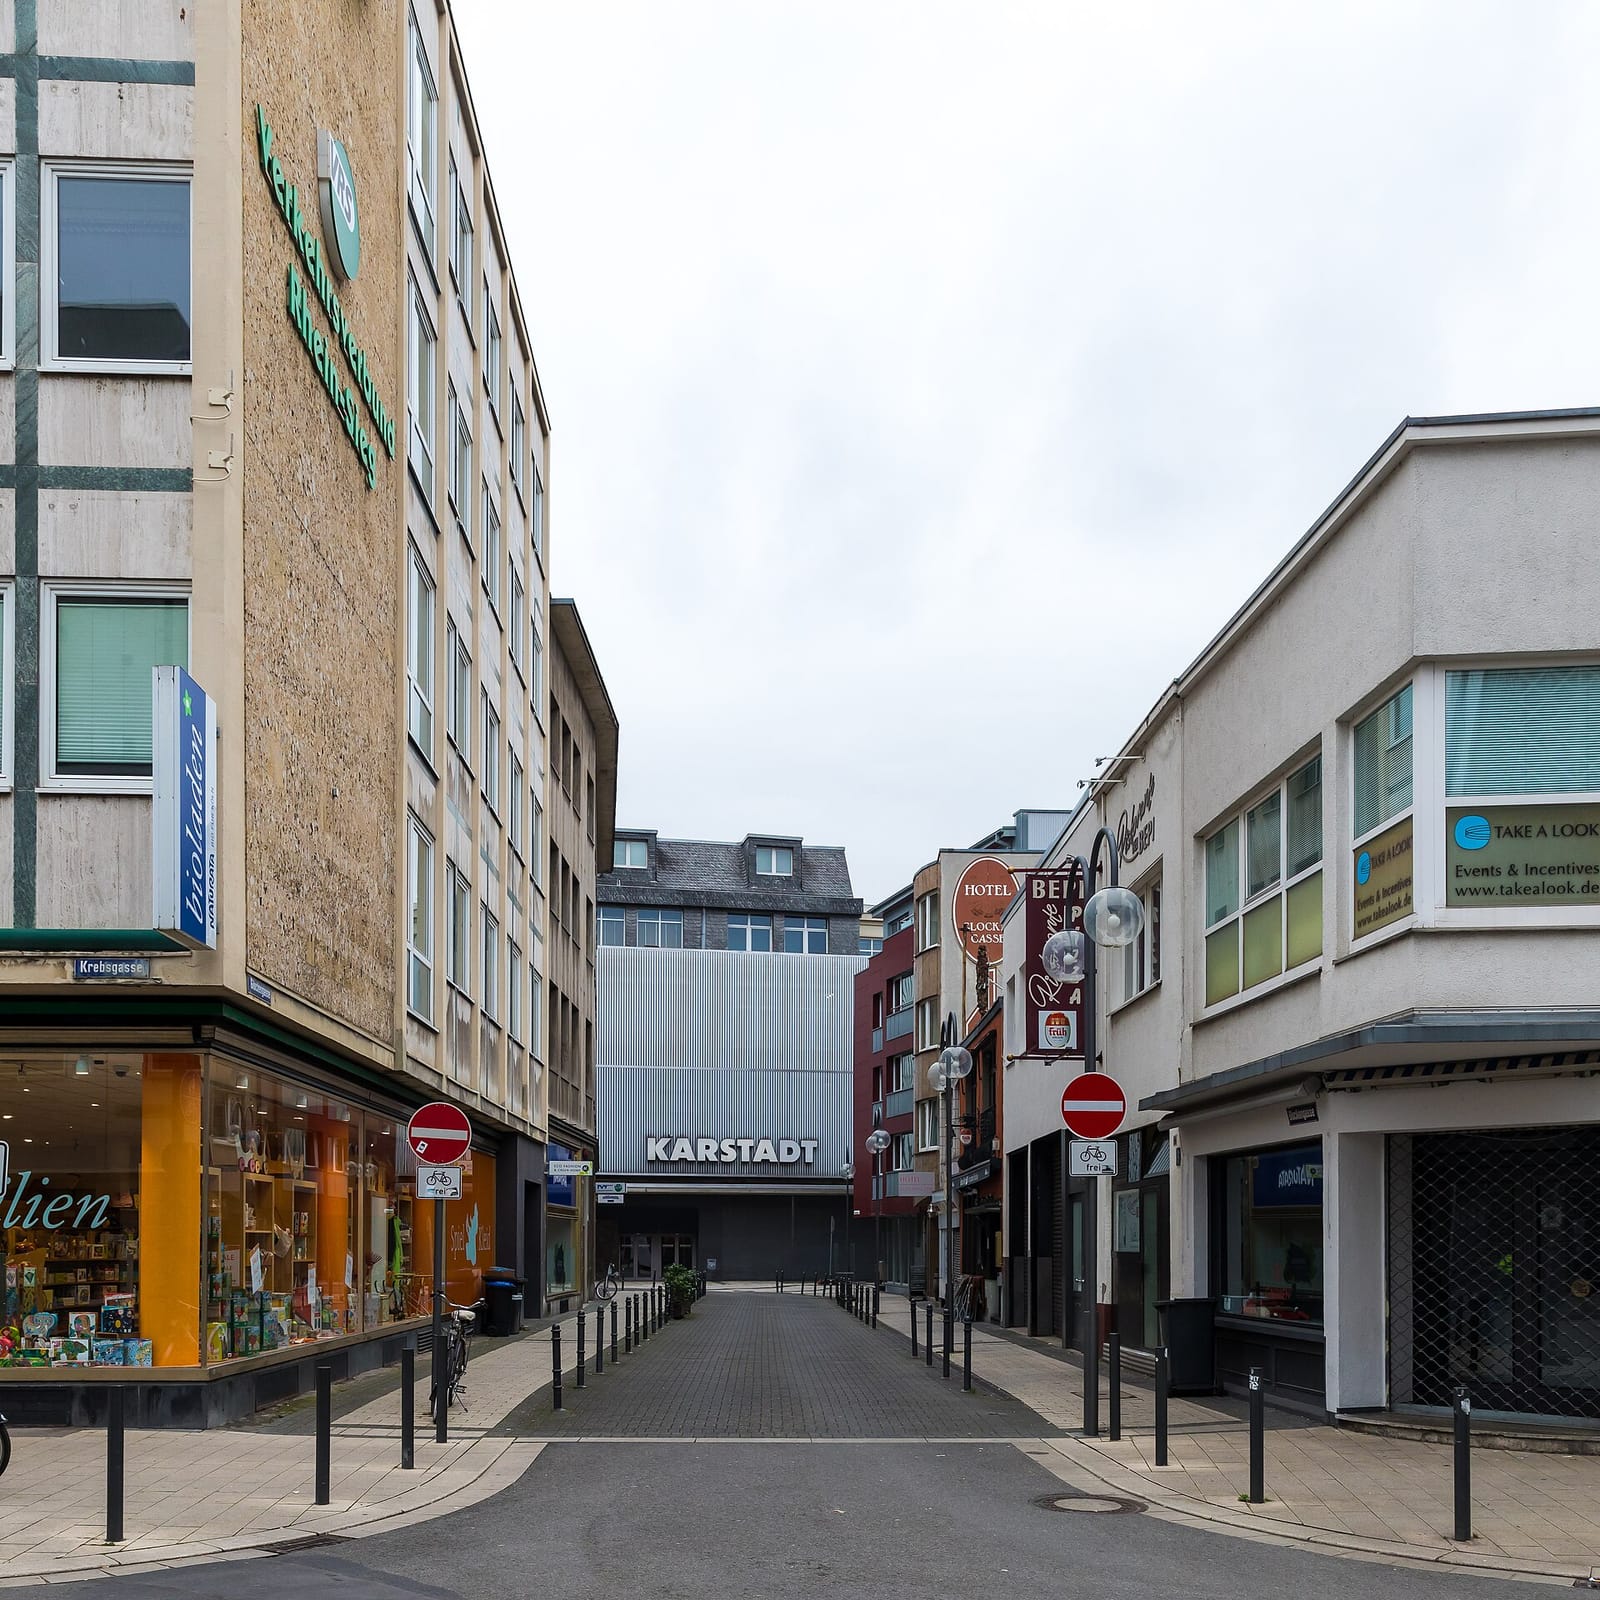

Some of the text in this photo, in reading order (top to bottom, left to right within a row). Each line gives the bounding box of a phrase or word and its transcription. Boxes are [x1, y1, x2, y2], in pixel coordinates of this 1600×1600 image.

[331, 138, 353, 224] VRS
[257, 104, 395, 461] Verkehrsverbund
[288, 263, 376, 490] Rhein-Sieg
[186, 724, 203, 924] bioladen
[1494, 824, 1599, 838] TAKE A LOOK
[1455, 861, 1599, 878] Events & Incentives
[964, 885, 1012, 896] HOTEL
[1357, 895, 1374, 912] Events
[1382, 876, 1411, 898] Incentives
[1455, 880, 1599, 897] www.takealook.de
[1357, 892, 1411, 928] www.takealook.de
[80, 960, 143, 976] Krebsgasse
[1049, 1027, 1068, 1037] früh
[647, 1137, 818, 1163] KARSTADT
[1086, 1163, 1101, 1172] frei
[451, 1224, 465, 1260] Spiel
